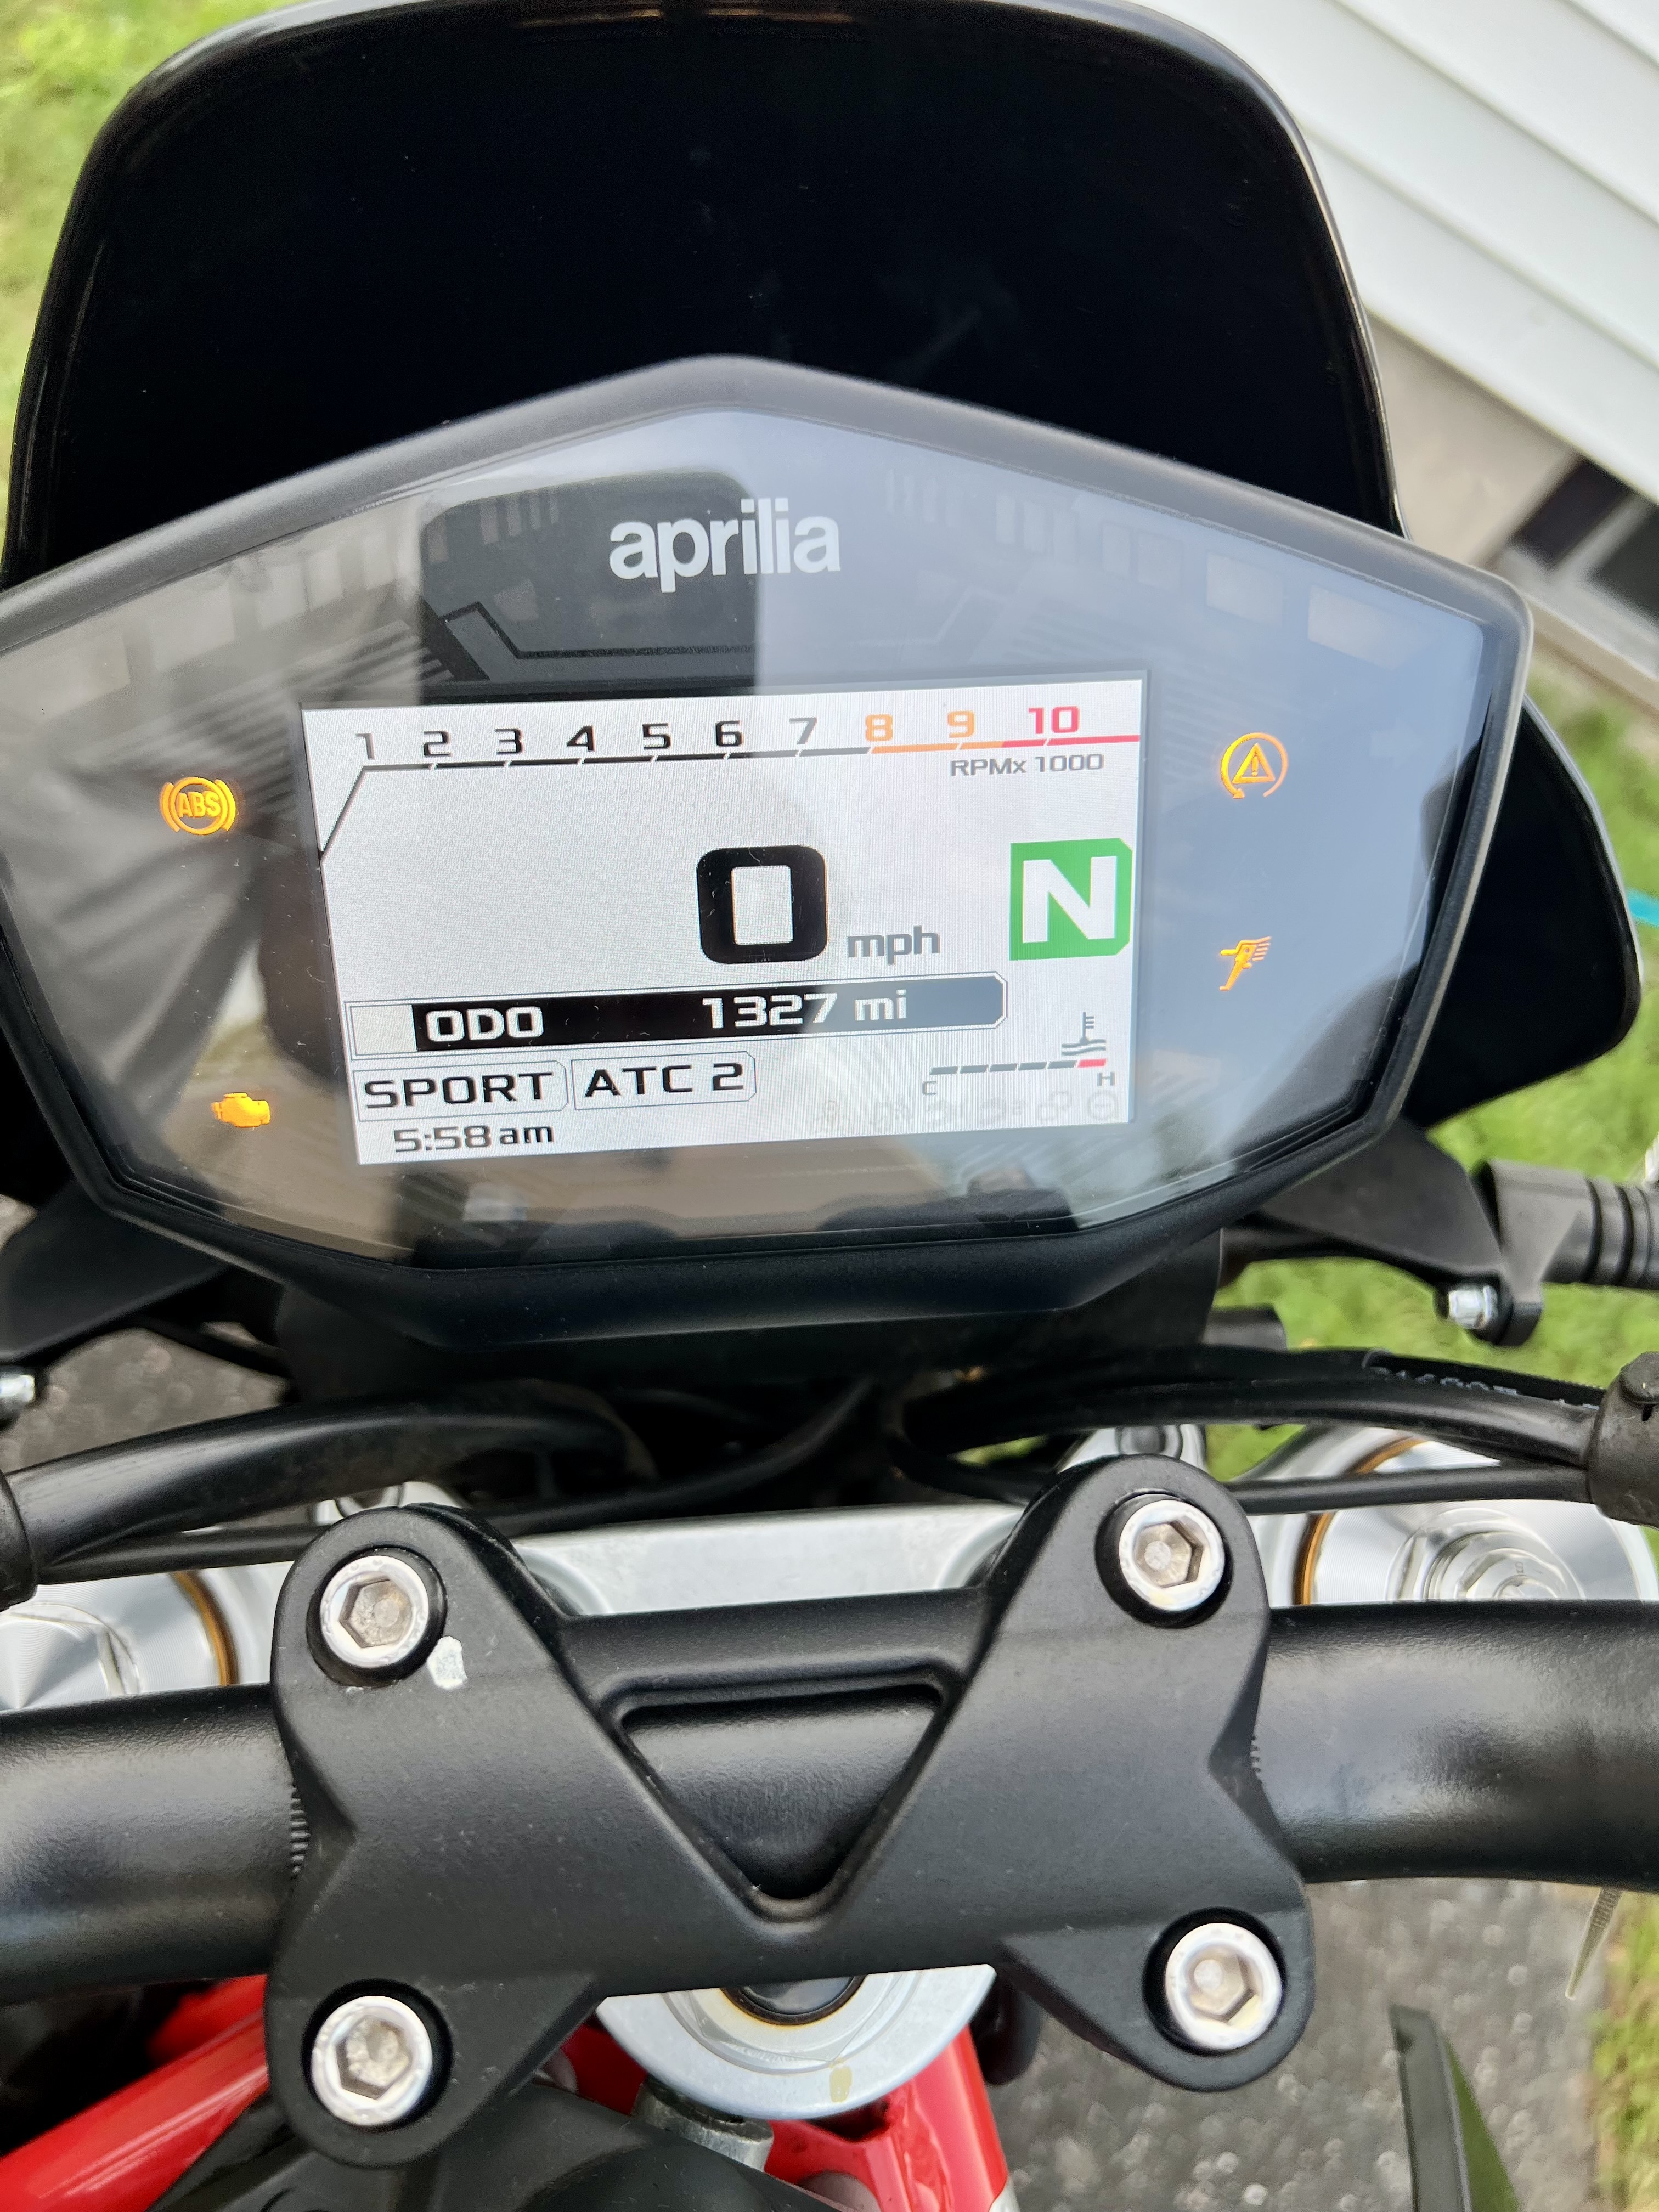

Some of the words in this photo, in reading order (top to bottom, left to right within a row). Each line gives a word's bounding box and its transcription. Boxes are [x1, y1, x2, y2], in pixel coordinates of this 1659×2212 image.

[609, 497, 841, 593] aprilia
[356, 732, 375, 760] 1
[423, 731, 452, 757] 2
[494, 728, 524, 754] 3
[566, 725, 596, 752] 4
[642, 723, 672, 751] 5
[715, 720, 743, 747] 6
[789, 717, 817, 744] 7
[865, 714, 893, 742] 8
[947, 710, 975, 738] 9
[1029, 706, 1080, 735] 10
[1035, 753, 1104, 773] 1000
[176, 791, 221, 817] ABS
[697, 845, 827, 964] 0
[1022, 856, 1117, 943] N
[848, 925, 940, 965] mph
[425, 1006, 544, 1042] ODO
[702, 992, 837, 1029] 1327
[854, 990, 907, 1022] mi
[364, 1071, 554, 1108] SPORT
[585, 1065, 692, 1097] ATC
[713, 1062, 744, 1091] 2
[1098, 1071, 1116, 1087] H
